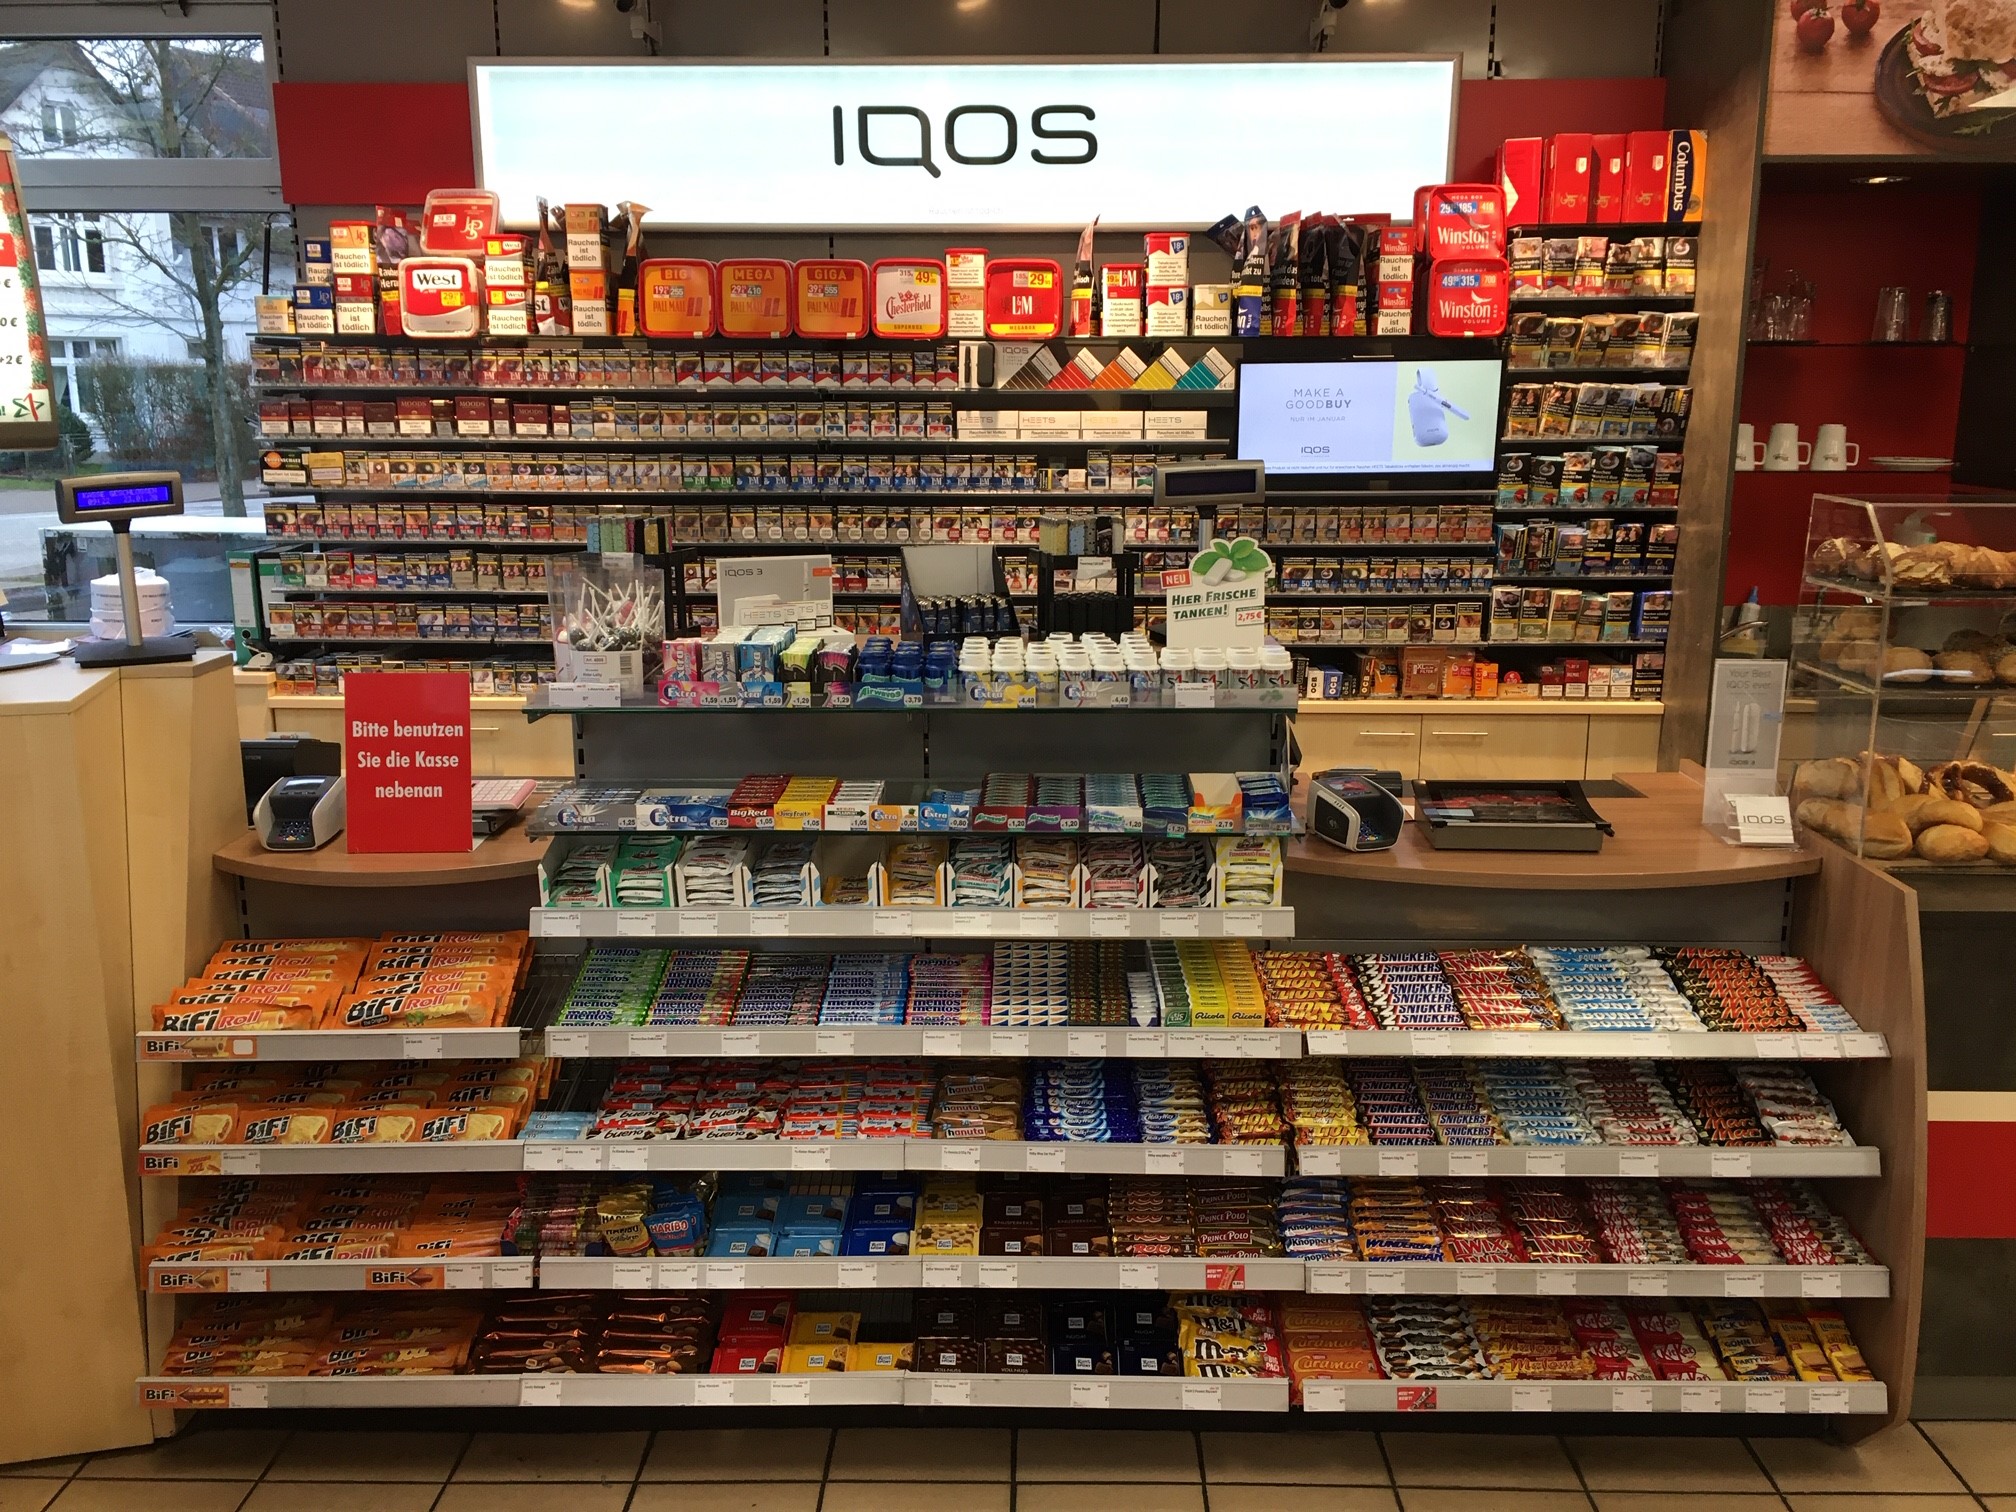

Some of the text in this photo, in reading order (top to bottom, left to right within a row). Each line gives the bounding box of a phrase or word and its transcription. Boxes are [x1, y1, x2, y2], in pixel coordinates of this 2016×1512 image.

[833, 104, 1099, 177] IQOS
[1673, 141, 1690, 212] Columbus
[1438, 226, 1489, 243] Winston
[1384, 244, 1408, 252] Winston
[572, 254, 596, 262] tödlich
[344, 260, 369, 268] tödlich
[417, 272, 457, 286] West
[664, 269, 687, 280] BIG
[734, 269, 772, 280] MEGA
[814, 269, 847, 280] GIGA
[1120, 270, 1136, 287] L&M
[1383, 272, 1408, 280] tödlich
[886, 295, 932, 319] Chesterfield
[1012, 296, 1033, 315] L&M
[1383, 298, 1407, 306] Winston
[1378, 310, 1411, 318] Rauchen
[1440, 300, 1491, 318] Winston
[342, 323, 370, 331] tödlich
[577, 320, 602, 328] tödlich
[1381, 326, 1406, 334] tödlich
[1002, 347, 1029, 355] IQOS
[1294, 388, 1344, 397] MAKE A
[1286, 400, 1352, 409] GOODBUY
[1301, 446, 1330, 454] IQOS
[724, 568, 763, 577] IQOS 3
[1166, 574, 1186, 584] NEU
[1172, 588, 1257, 606] HIER FRISCHE
[743, 610, 782, 619] HEETS
[1173, 605, 1228, 620] TANKEN!
[1729, 669, 1748, 677] Your
[1361, 675, 1369, 694] OCB
[1726, 681, 1750, 690] IQOS
[667, 687, 697, 698] Extra
[857, 687, 904, 702] Airwaves
[352, 720, 464, 737] Bitte benutzen
[357, 751, 459, 768] Sie die Kasse
[376, 781, 443, 798] nebenan
[655, 812, 688, 824] Extra
[874, 812, 898, 820] Extra
[924, 808, 948, 819] Extra
[1743, 815, 1785, 824] IQOS
[1380, 952, 1440, 962] SNICKERS
[1688, 958, 1750, 969] Mars
[664, 978, 712, 988] mentos
[1454, 971, 1508, 984] TWIX
[914, 990, 962, 998] mentos
[1390, 983, 1451, 994] SNICKERS
[658, 993, 707, 1001] mentos
[1392, 993, 1453, 1004] SNICKERS
[346, 994, 445, 1023] BiFi Roll
[220, 1010, 261, 1028] Roll
[565, 1010, 615, 1020] mentos
[1195, 1012, 1225, 1020] Ricola
[1232, 1012, 1263, 1020] Ricola
[1401, 1013, 1463, 1024] SNICKERS
[650, 1018, 699, 1026] mentos
[146, 1040, 180, 1053] BiFi
[948, 1085, 983, 1094] hanuta
[1427, 1091, 1472, 1100] SNICKERS
[620, 1110, 658, 1118] bueno
[710, 1108, 748, 1118] bueno
[1369, 1104, 1425, 1114] SNICKERS
[1373, 1115, 1429, 1125] SNICKERS
[1440, 1115, 1486, 1124] SNICKERS
[146, 1115, 192, 1142] BiFi
[245, 1115, 292, 1141] BiFi
[332, 1116, 377, 1140] BiFi
[421, 1113, 469, 1140] BiFi
[949, 1128, 984, 1136] hanuta
[1445, 1127, 1490, 1136] SNICKERS
[604, 1129, 644, 1138] bueno
[707, 1130, 746, 1138] bueno
[145, 1157, 179, 1170] BiFi
[1200, 1211, 1246, 1223] PRINCE POLO
[650, 1221, 688, 1234] HARIBO
[1201, 1231, 1249, 1243] PRINCE POLO
[1291, 1237, 1335, 1245] Knoppers
[1366, 1239, 1443, 1249] WUNDERBAR
[1454, 1239, 1504, 1254] TWIX
[1369, 1253, 1443, 1262] WUNDERBAR
[160, 1274, 194, 1287] BiFi
[372, 1271, 405, 1285] BiFi
[1589, 1342, 1628, 1358] KitKat
[1657, 1342, 1697, 1360] KitKat
[1294, 1356, 1364, 1373] Caramac
[146, 1389, 175, 1401] BiFi
